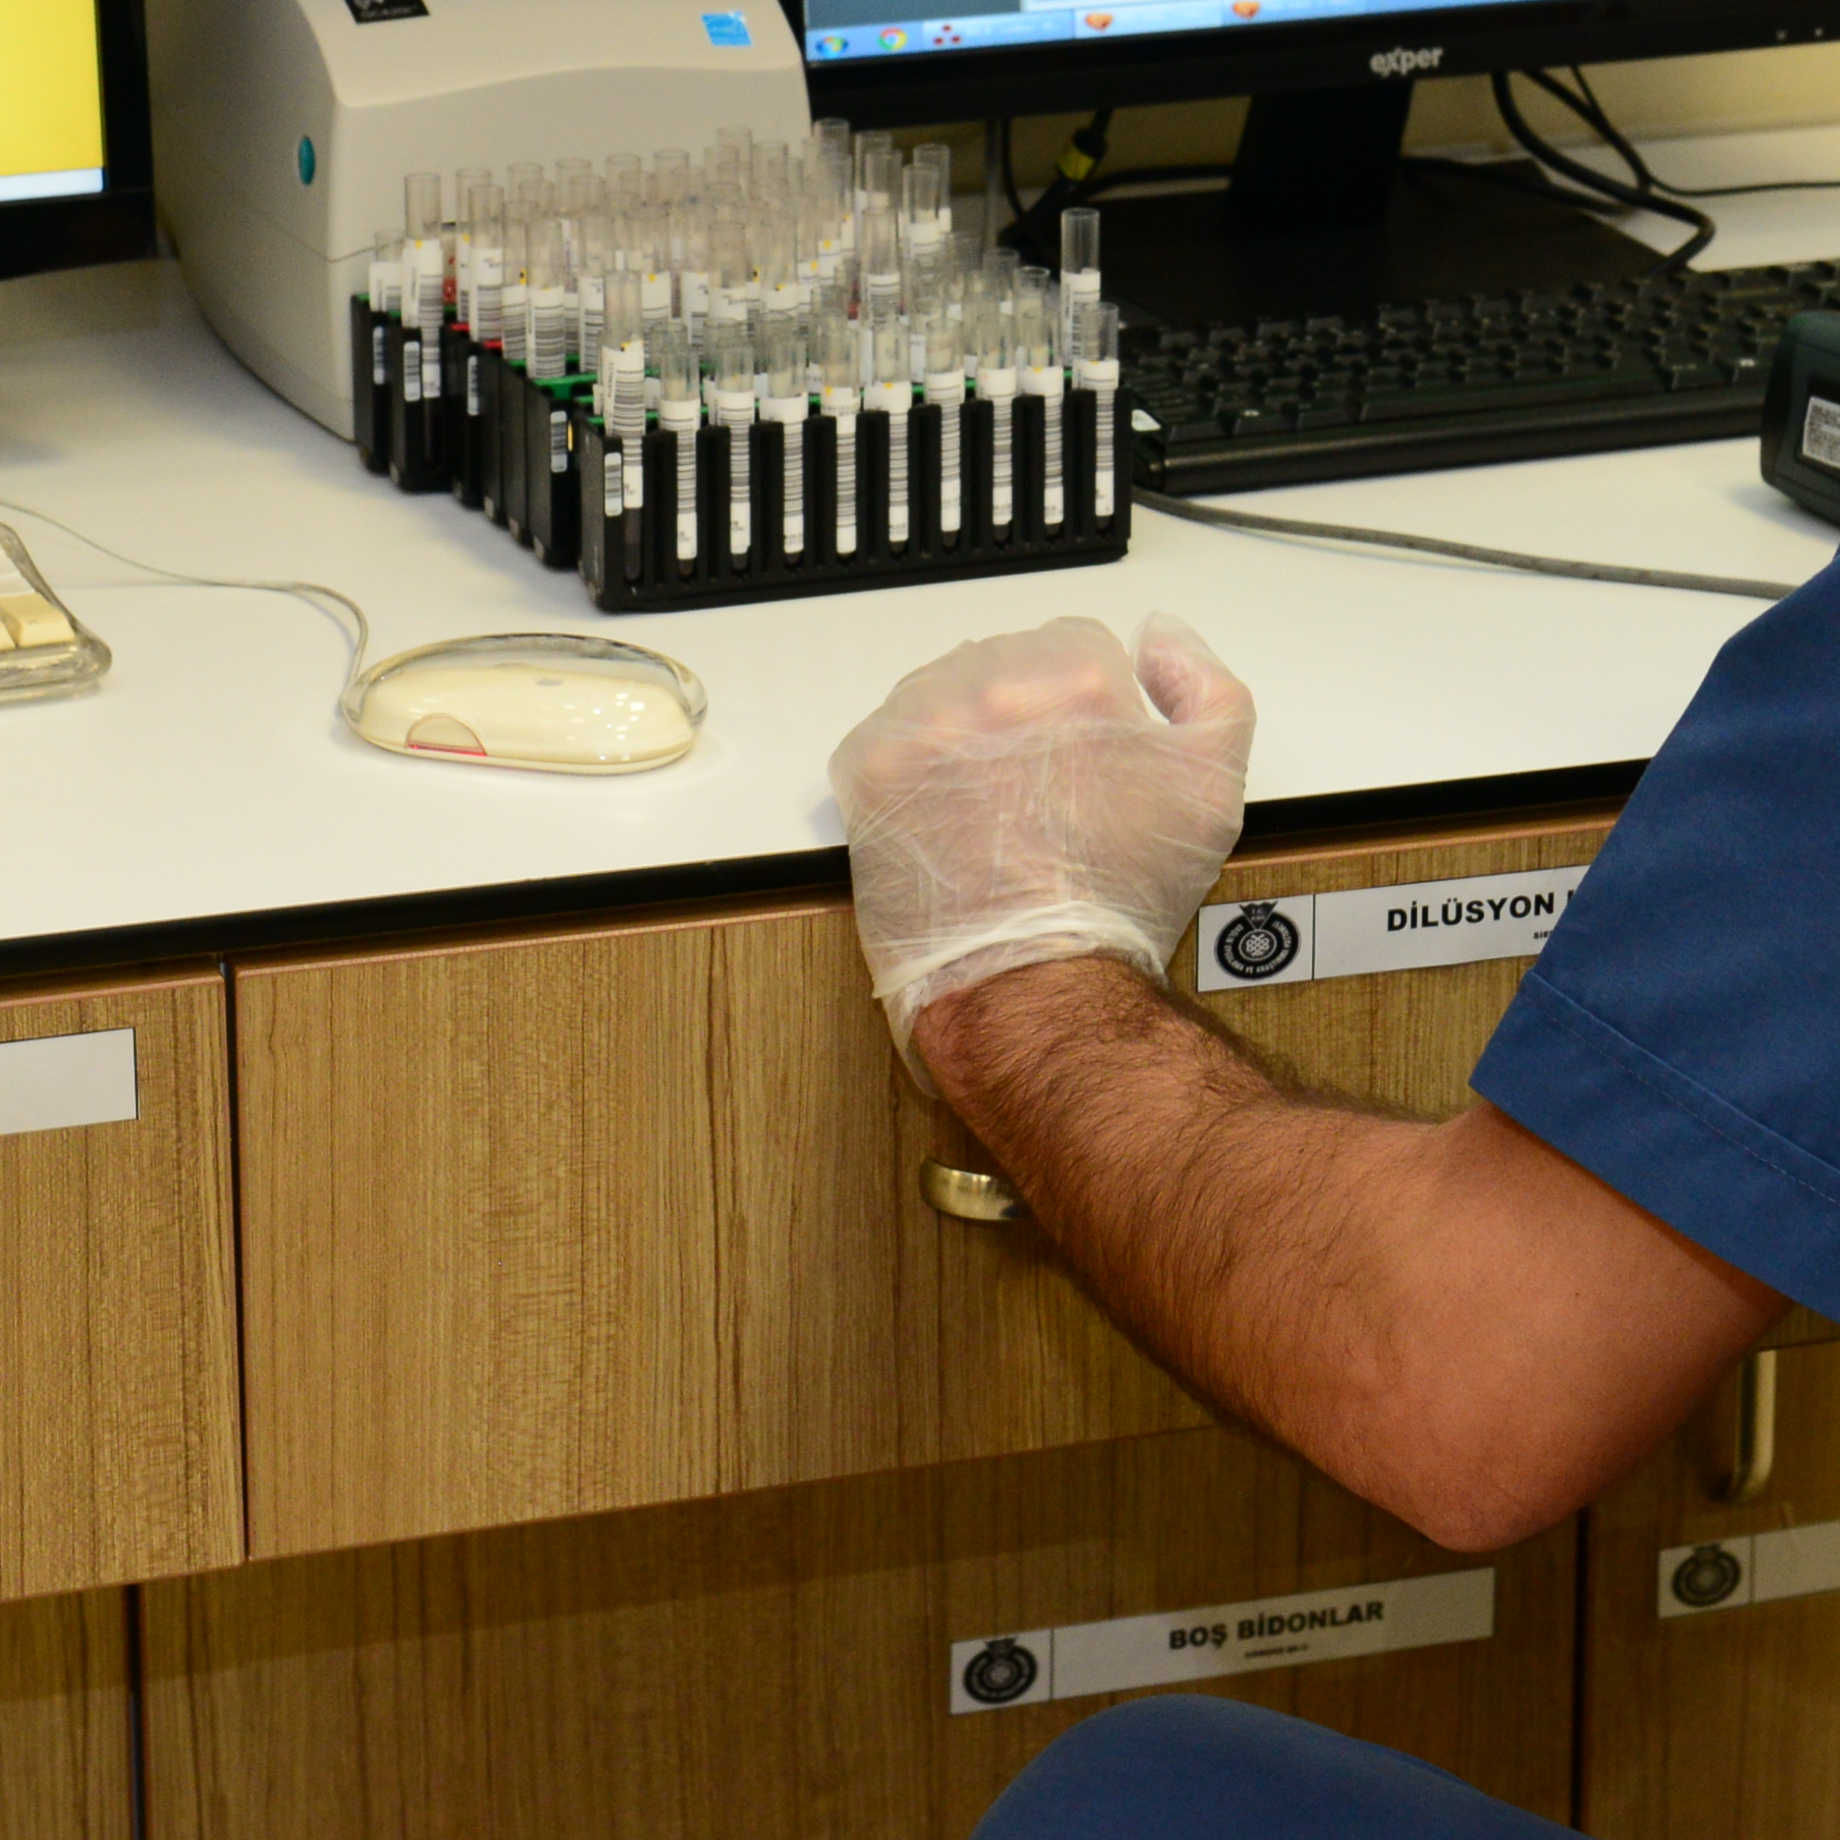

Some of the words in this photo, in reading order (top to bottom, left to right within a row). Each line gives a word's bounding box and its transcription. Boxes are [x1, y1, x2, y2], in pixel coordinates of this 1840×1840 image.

[1369, 45, 1445, 78] exper
[1386, 892, 1556, 933] DİLÜSYON
[1169, 1623, 1228, 1651] BOŞ
[1237, 1600, 1386, 1641] BİDONLAR
